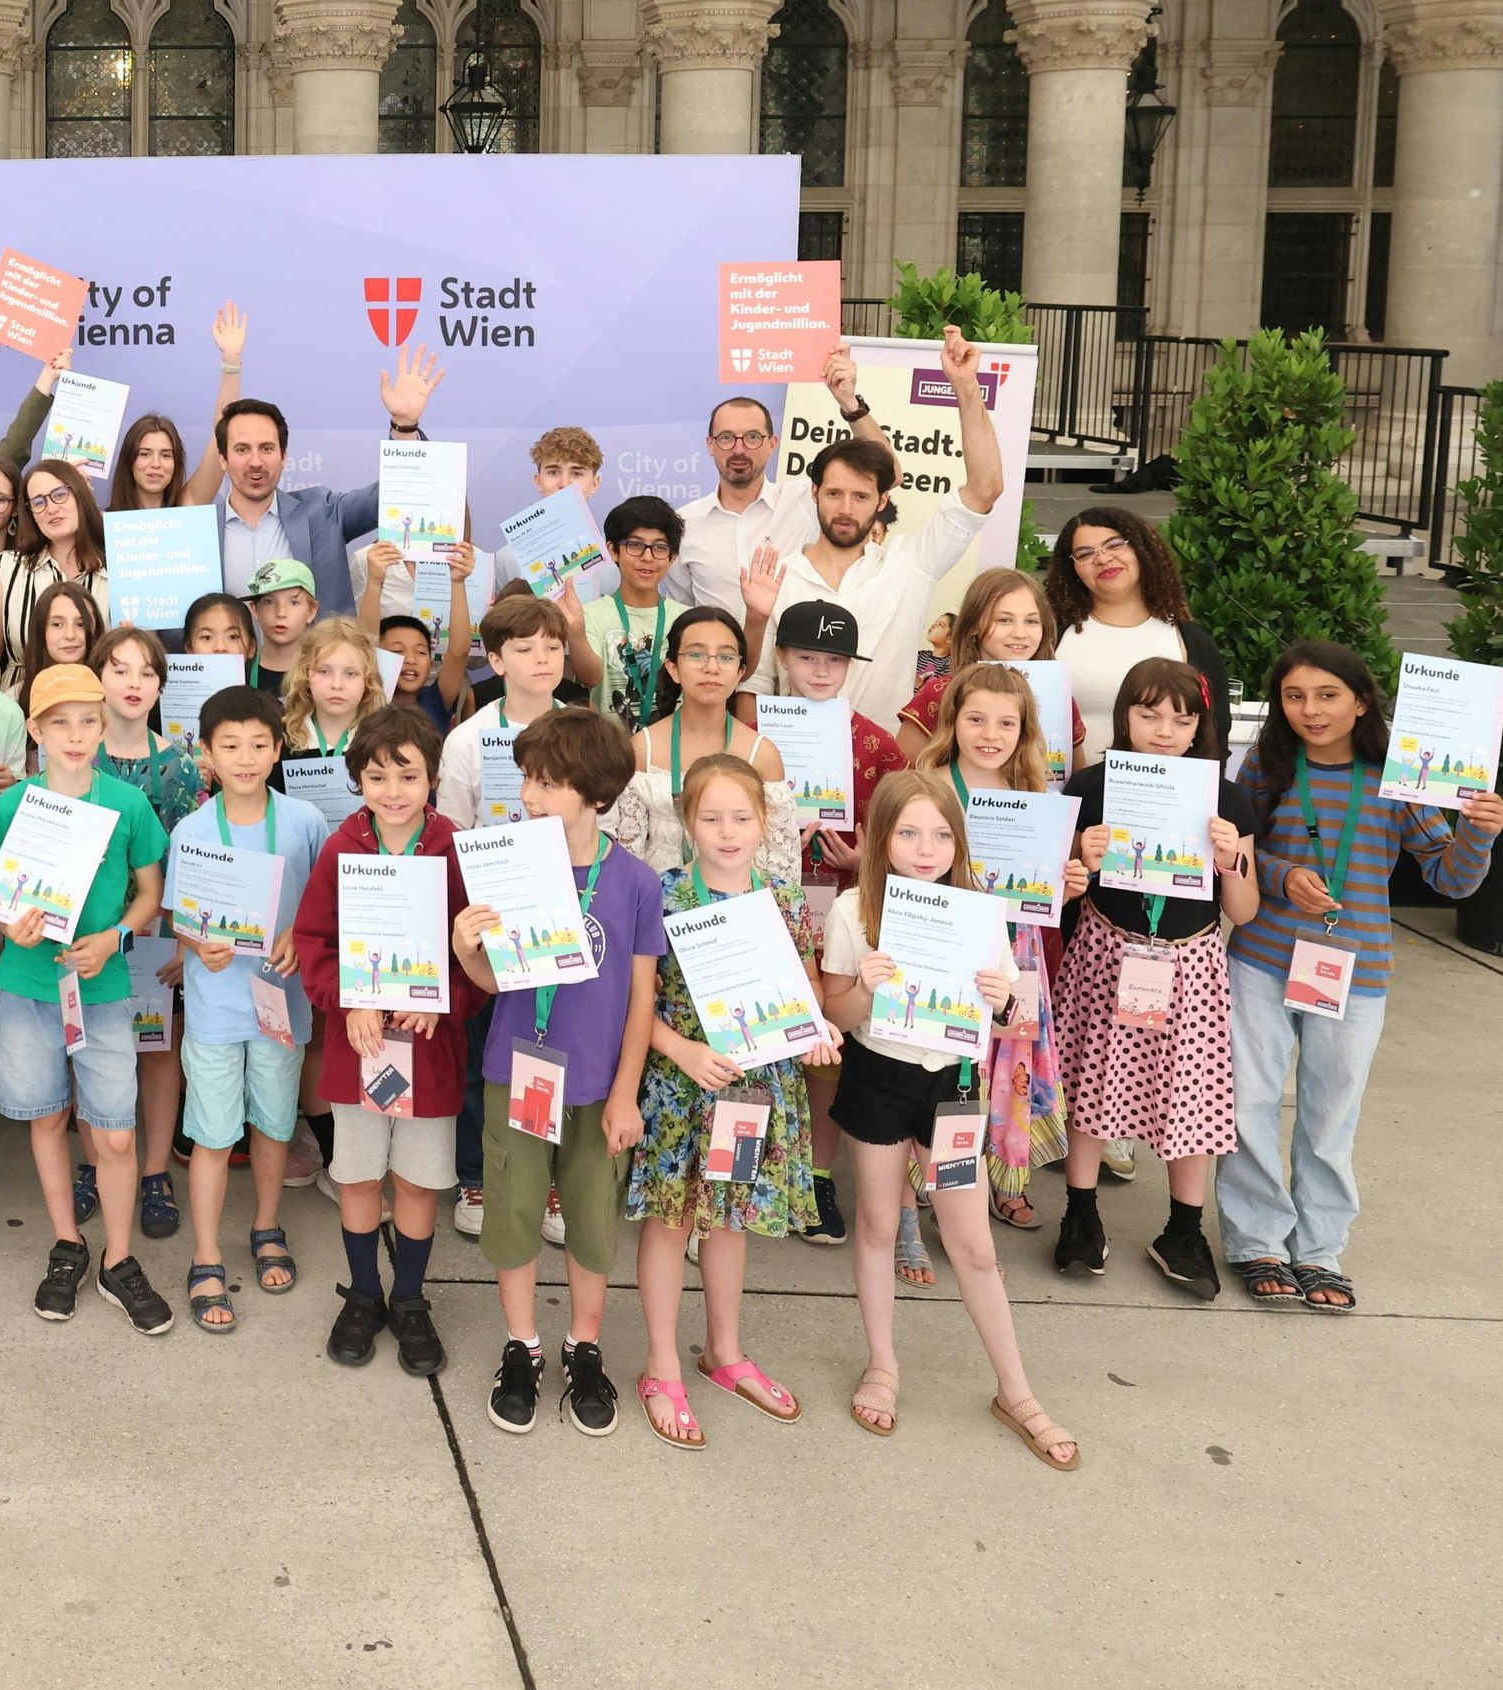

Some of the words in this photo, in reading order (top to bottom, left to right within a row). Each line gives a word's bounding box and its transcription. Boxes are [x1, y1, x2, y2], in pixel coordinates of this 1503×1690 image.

[4, 269, 22, 283] mit
[22, 274, 40, 290] der
[7, 257, 62, 288] Ermöglicht
[729, 272, 804, 287] Ermöglicht
[1, 280, 38, 302] Kinder-
[39, 295, 59, 310] und
[133, 276, 172, 307] of
[440, 276, 537, 310] Stadt
[730, 288, 753, 299] mit
[755, 287, 778, 299] der
[730, 303, 782, 314] Kinder-
[784, 302, 810, 314] und
[9, 319, 37, 337] Stadt
[78, 315, 175, 346] ienna
[439, 315, 535, 347] Wien
[729, 317, 831, 333] Jugendmillion.
[6, 328, 33, 347] Wien
[758, 348, 794, 360] Stadt
[758, 361, 794, 373] Wien
[61, 376, 97, 391] Urkunde
[921, 384, 956, 396] JUNGE
[790, 417, 854, 444] Dein
[383, 448, 427, 458] Urkunde
[284, 452, 324, 472] adt
[617, 451, 668, 479] City
[673, 452, 700, 473] of
[901, 472, 951, 494] een
[113, 518, 184, 534] Ermöglicht
[504, 506, 546, 535] Urkunde
[115, 537, 138, 548] mit
[139, 536, 160, 547] der
[116, 550, 166, 563] Kinder-
[167, 548, 191, 560] und
[117, 562, 211, 580] Jugendmillion.
[145, 595, 179, 606] Stadt
[146, 607, 180, 619] Wien
[167, 663, 205, 673] rkunde
[1404, 663, 1460, 681] Urkunde
[760, 704, 807, 716] Urkunde
[482, 737, 514, 747] Urku
[286, 766, 335, 778] Urkunde
[1108, 758, 1167, 775] Urkunde
[26, 793, 73, 816] Urkunde
[972, 796, 1028, 810] Urkunde
[459, 835, 515, 854] Urkunde
[180, 844, 235, 864] Urkunde
[342, 863, 397, 877] Urkunde
[889, 885, 950, 909] Urkunde
[670, 913, 728, 937] Urkunde
[678, 943, 696, 954] Olivia
